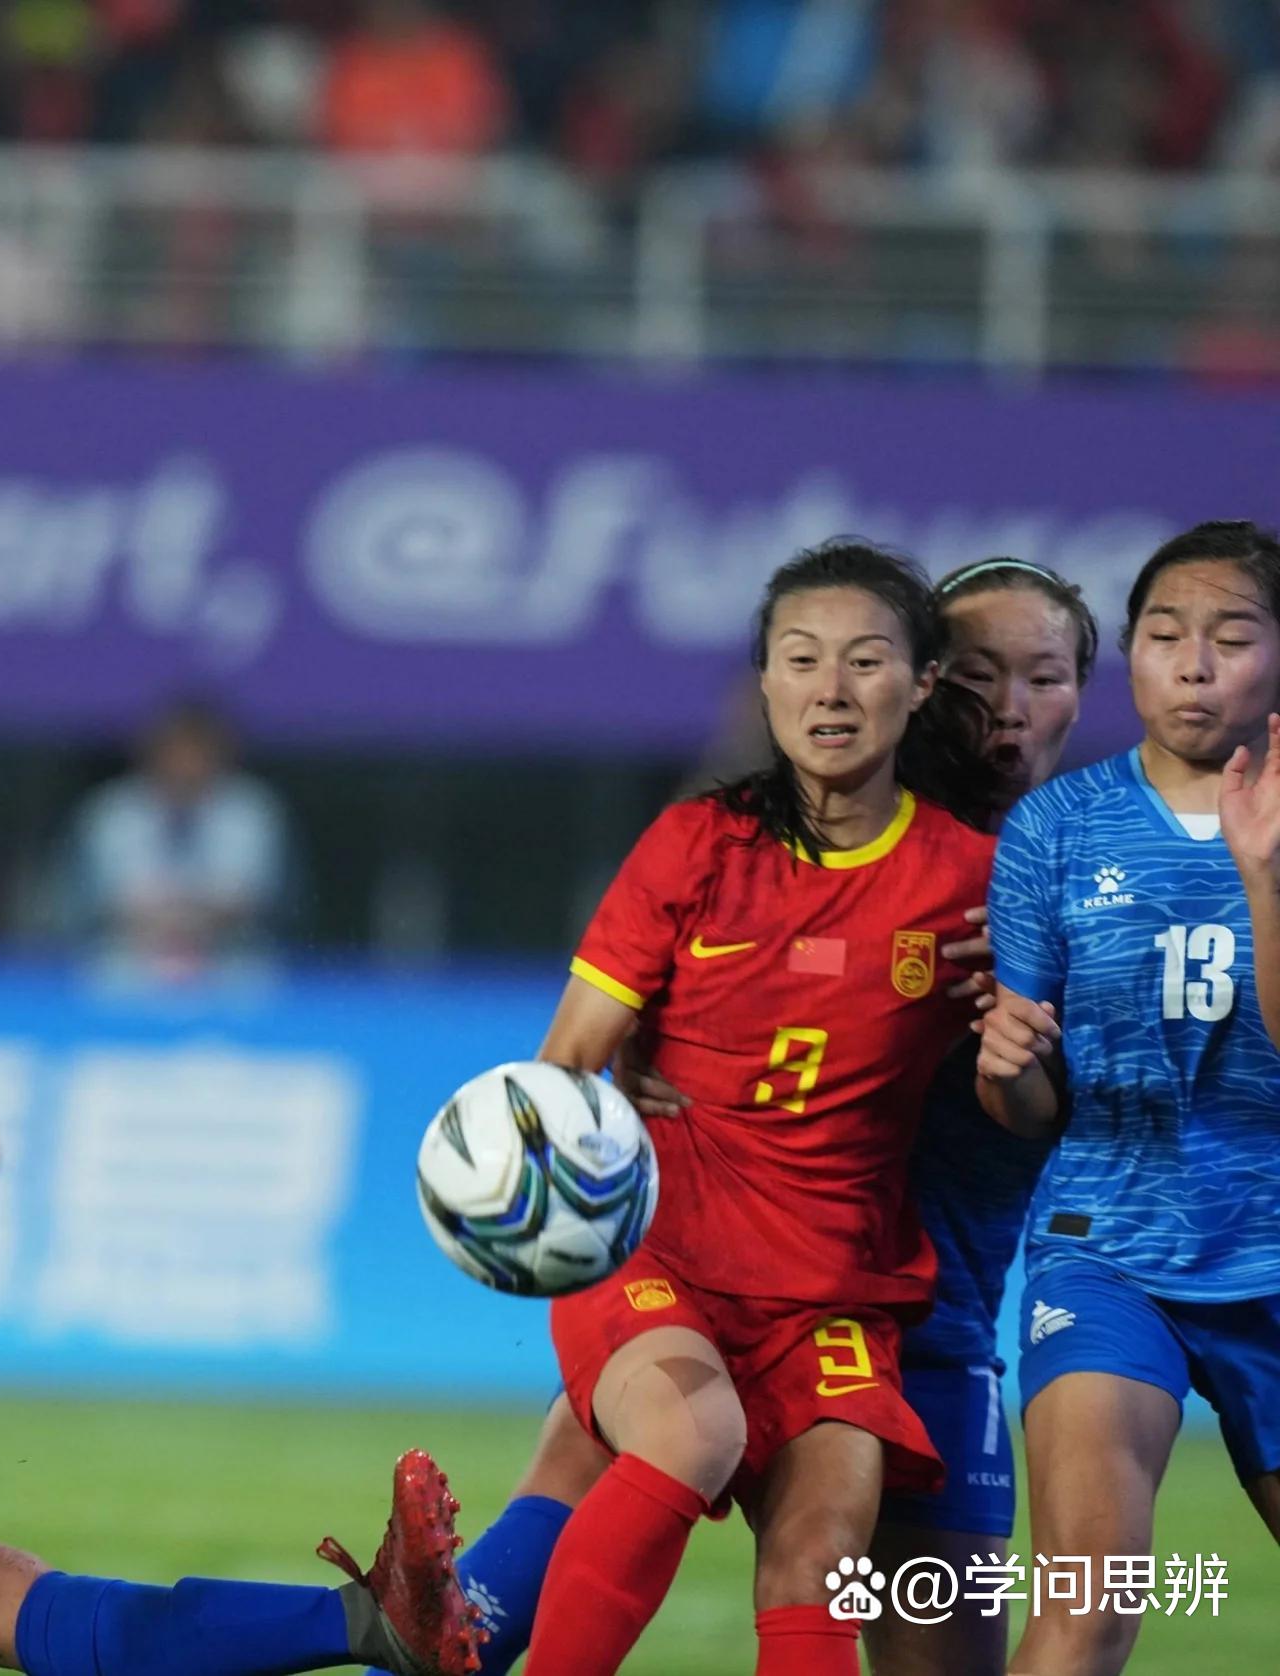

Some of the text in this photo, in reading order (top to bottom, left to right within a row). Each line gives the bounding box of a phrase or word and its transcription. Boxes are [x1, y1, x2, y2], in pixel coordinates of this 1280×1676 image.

[1083, 893, 1135, 909] KELME
[1154, 923, 1236, 1022] 13
[754, 1026, 828, 1115] 9
[814, 1317, 873, 1378] 9
